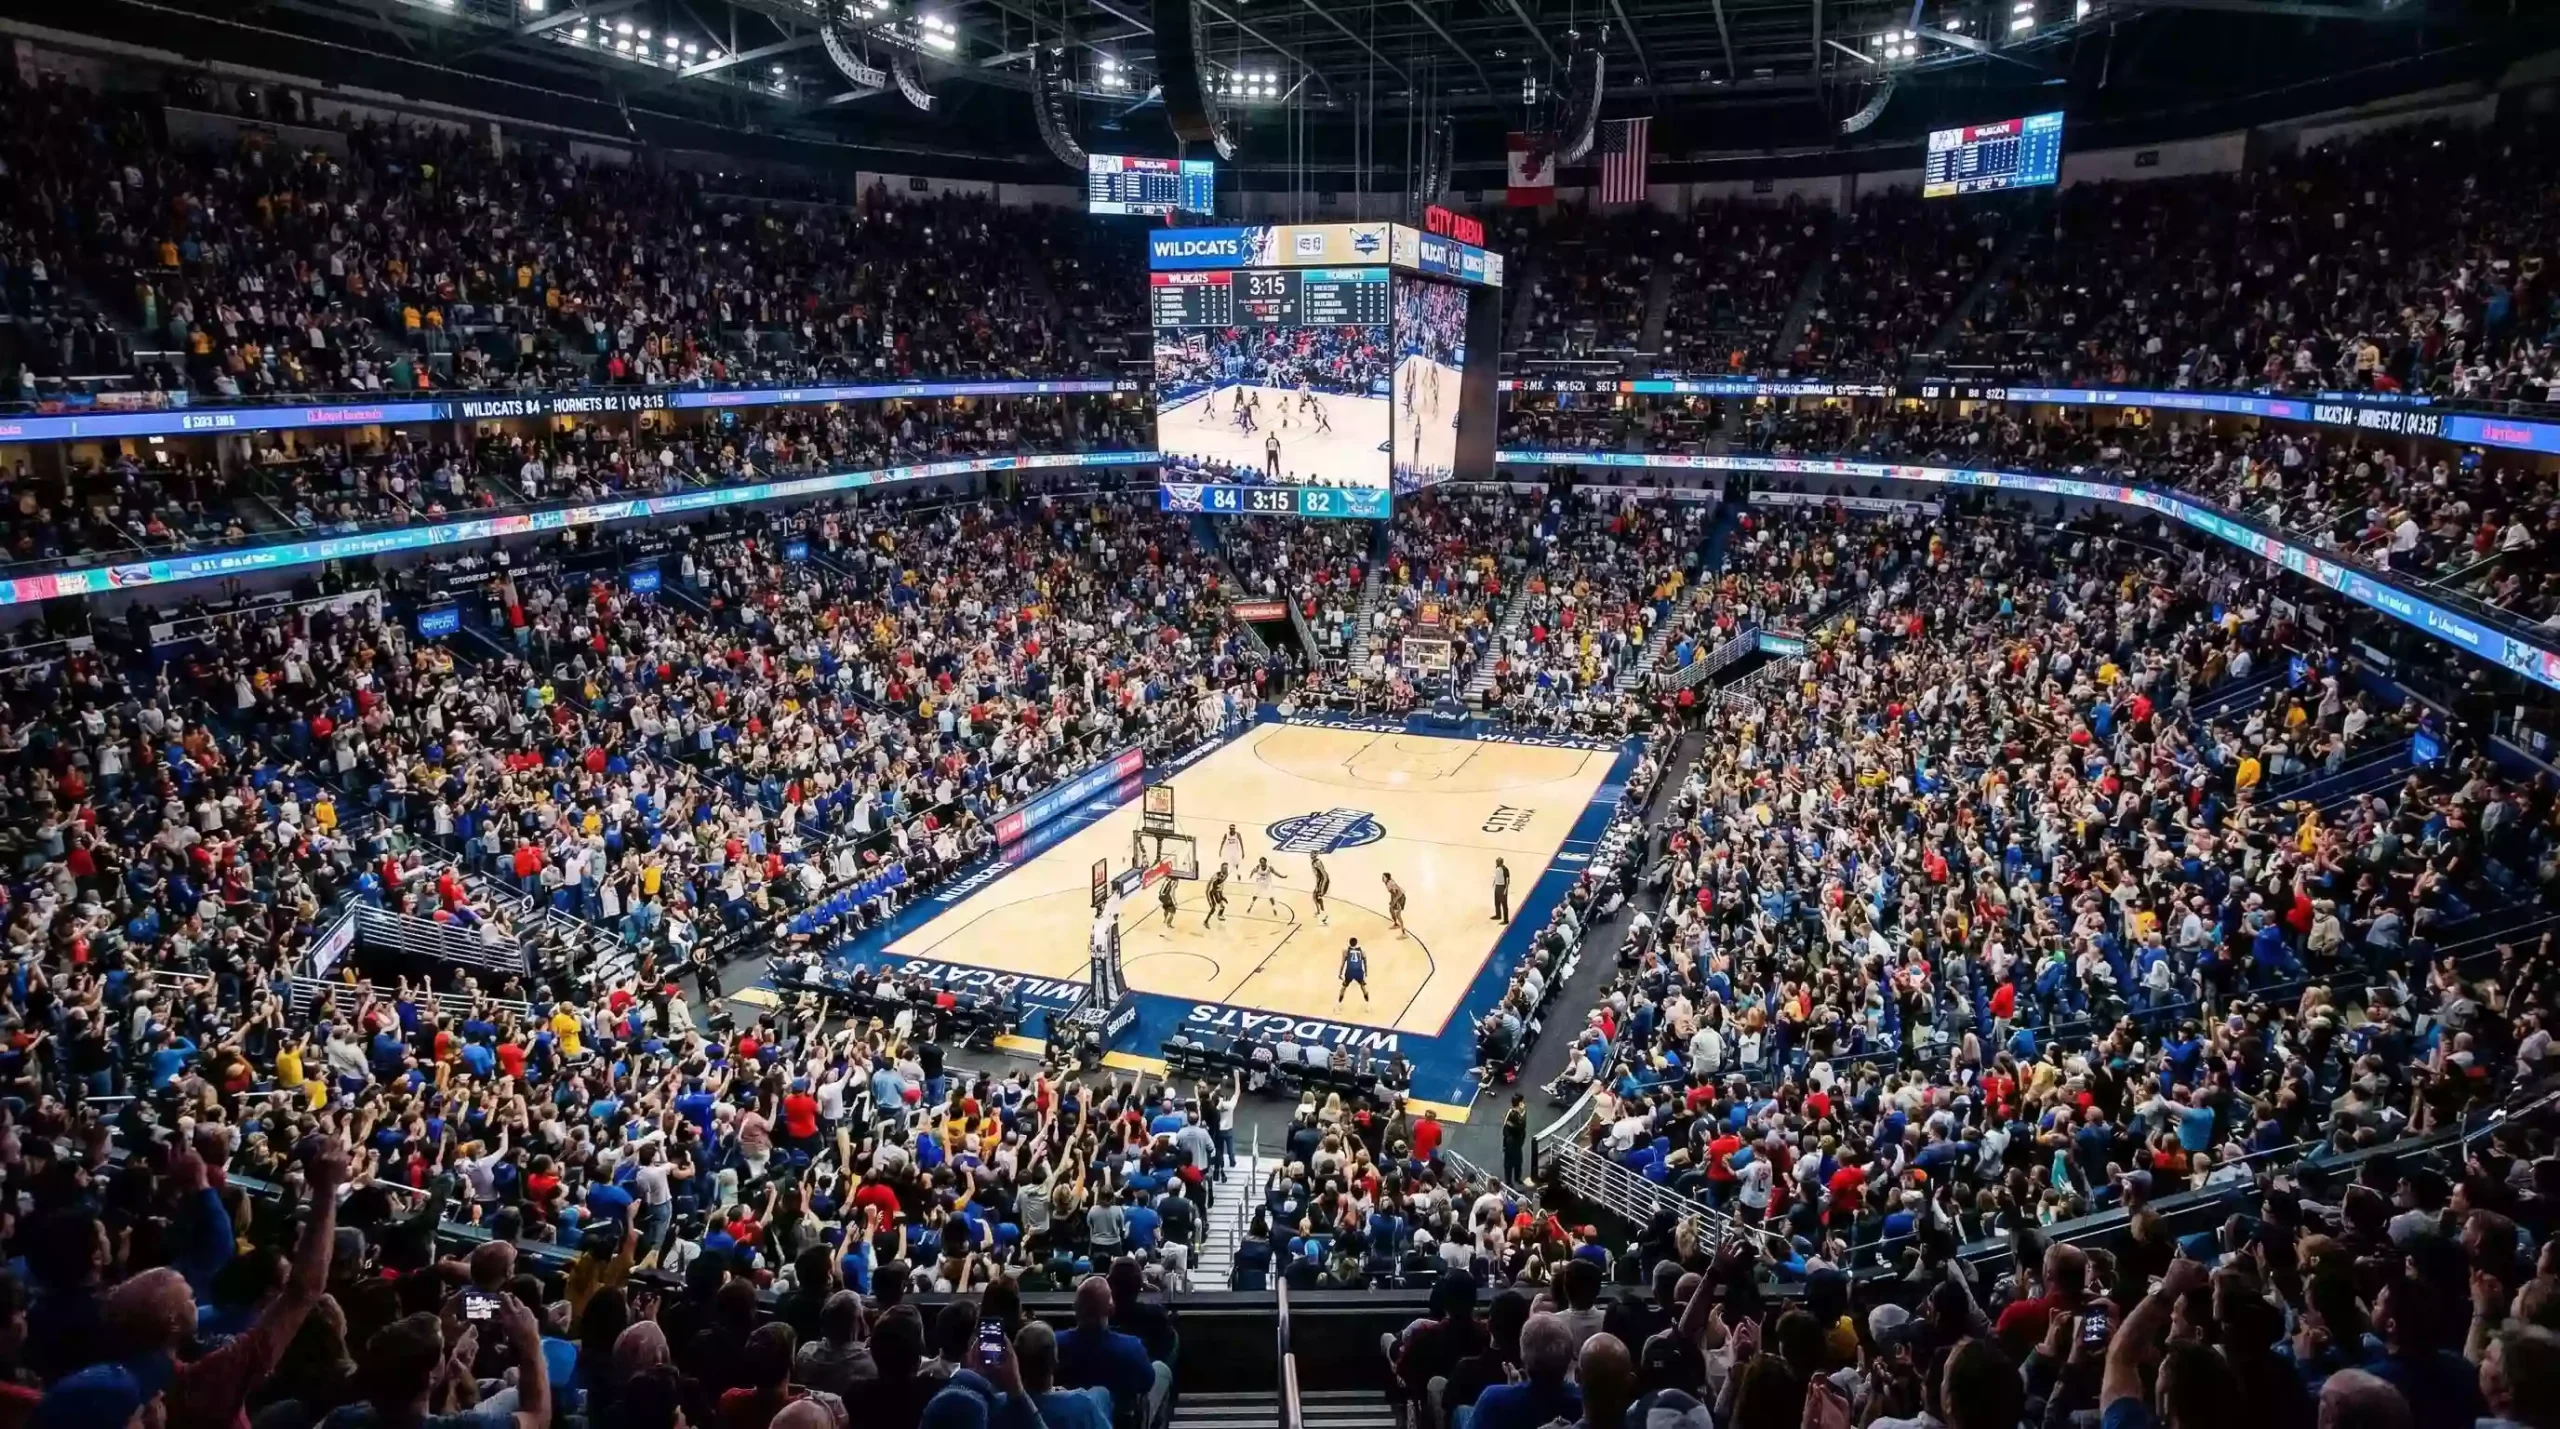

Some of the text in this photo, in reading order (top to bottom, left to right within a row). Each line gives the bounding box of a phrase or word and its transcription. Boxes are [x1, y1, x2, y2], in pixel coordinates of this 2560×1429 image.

[1426, 206, 1485, 248] CITY ARENA
[1154, 240, 1238, 257] WILDCATS
[1168, 273, 1209, 284] WILDCATS
[1250, 276, 1285, 296] 3:15
[462, 400, 523, 417] WILDCATS
[553, 398, 602, 413] HORNETS
[643, 394, 665, 408] 3:15
[1214, 491, 1236, 509] 84
[1252, 492, 1289, 510] 3:15
[1307, 493, 1329, 512] 82
[1287, 717, 1406, 734] WILDCATS
[1476, 733, 1611, 751] WILDCATS
[898, 959, 1083, 1002] WILDCATS
[1188, 1005, 1398, 1053] WILDCATS
